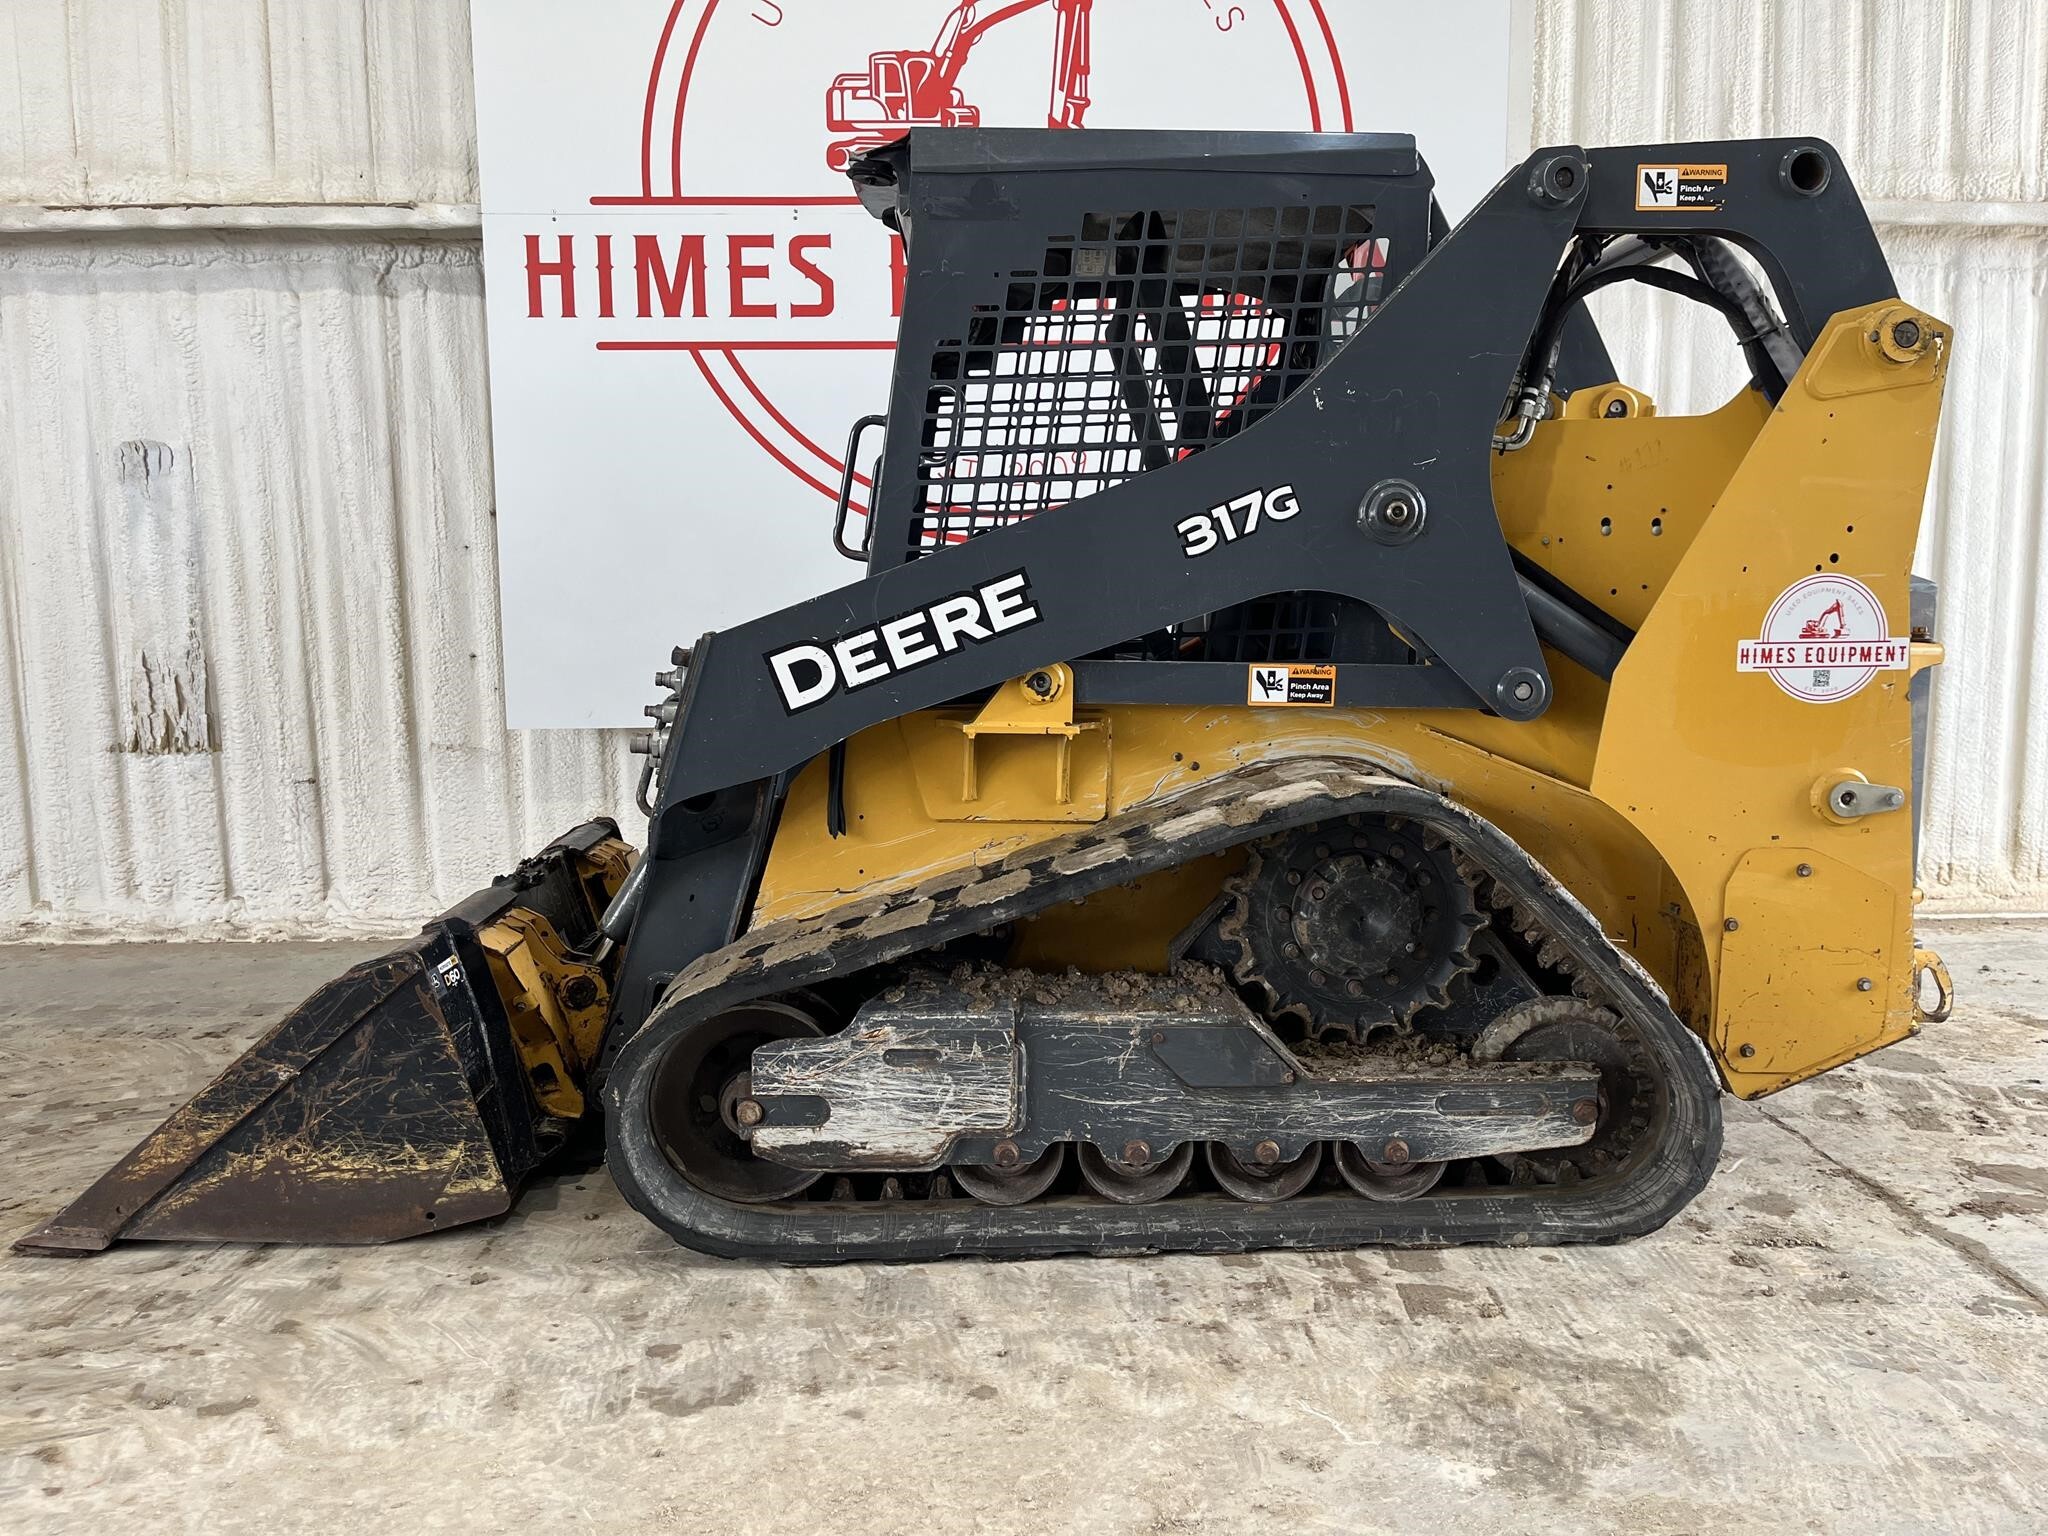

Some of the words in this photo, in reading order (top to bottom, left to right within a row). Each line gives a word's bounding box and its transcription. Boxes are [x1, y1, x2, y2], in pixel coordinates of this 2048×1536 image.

[1680, 185, 1702, 193] Pinch
[523, 233, 836, 319] HIMES
[1177, 485, 1300, 556] 317G
[1802, 587, 1847, 599] EQUIPMENT
[1847, 594, 1864, 616] SALES
[769, 573, 1037, 711] DEERE
[1740, 647, 1796, 664] HIMES
[1804, 645, 1907, 664] EQUIPMENT
[444, 968, 460, 987] D60
